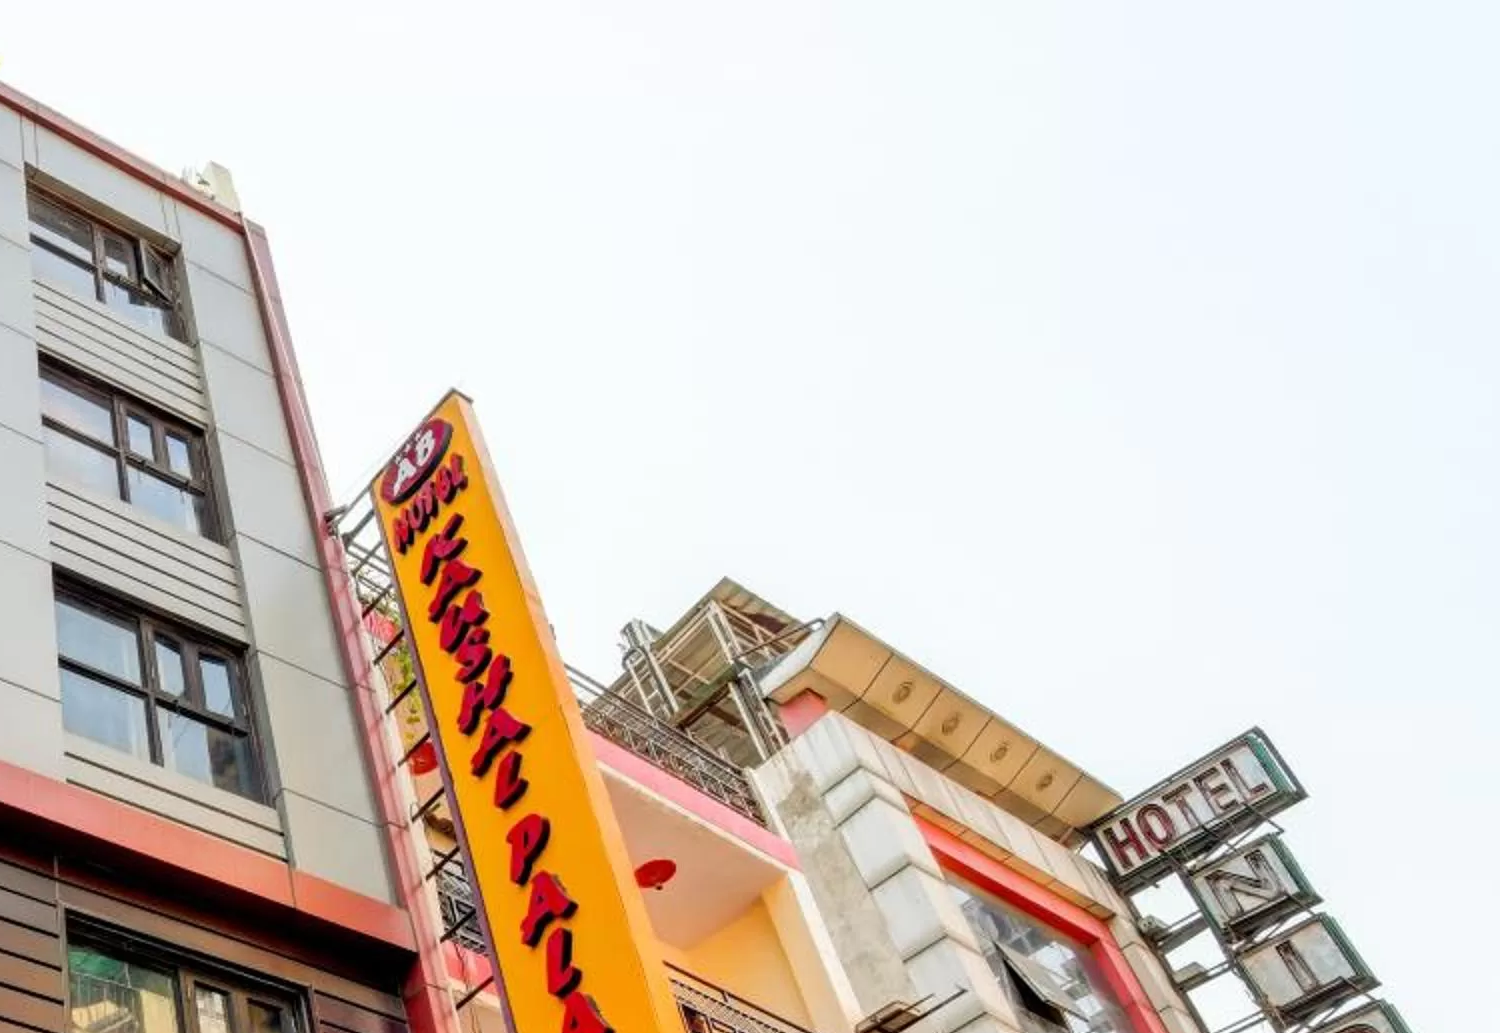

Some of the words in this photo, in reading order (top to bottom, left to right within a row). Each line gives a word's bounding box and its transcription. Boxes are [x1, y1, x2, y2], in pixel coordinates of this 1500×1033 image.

[393, 452, 468, 555] HOTEL
[420, 512, 530, 812] KAUSHAL
[1104, 755, 1272, 870] HOTEL
